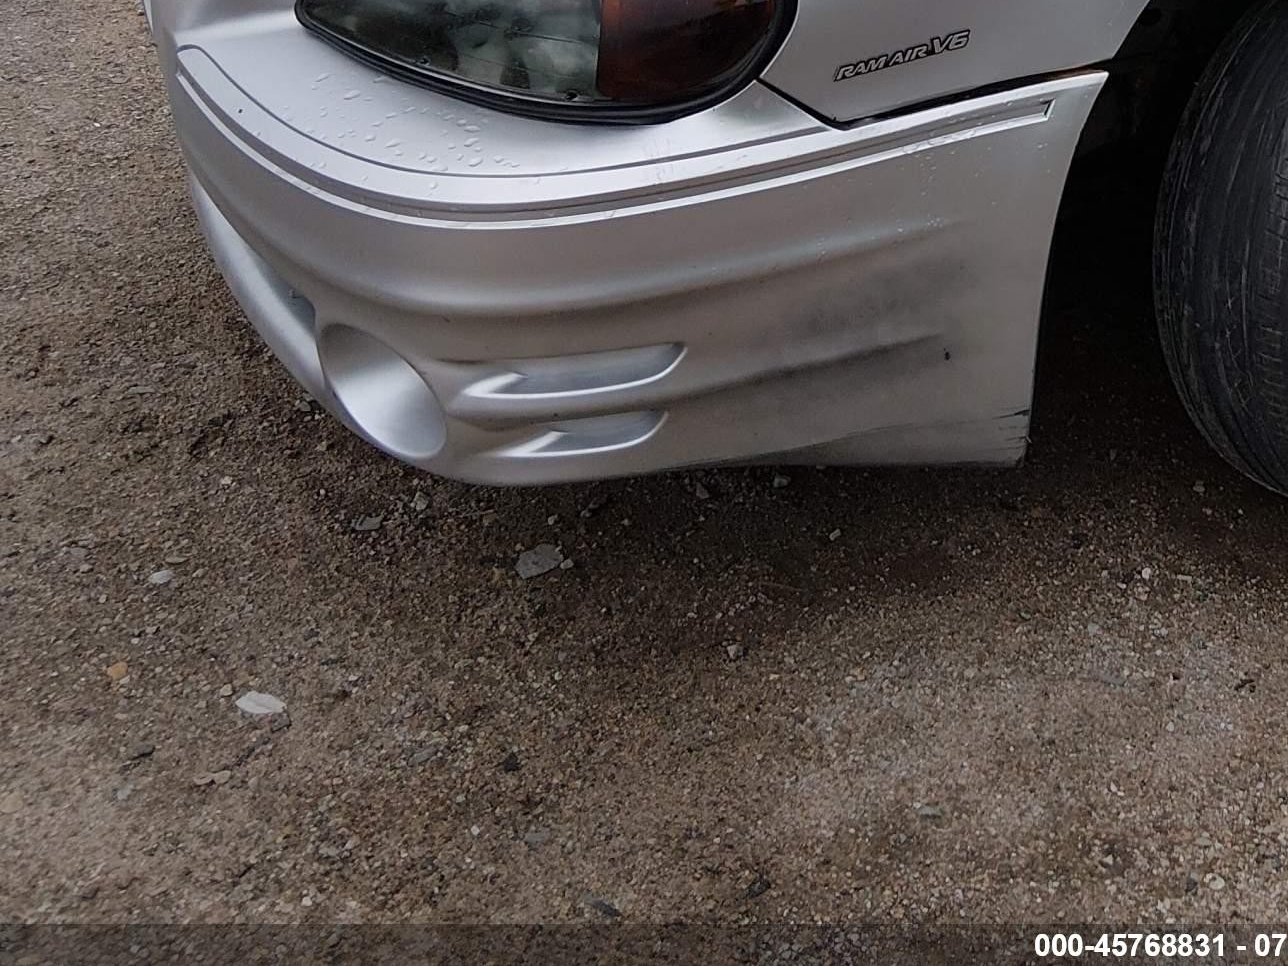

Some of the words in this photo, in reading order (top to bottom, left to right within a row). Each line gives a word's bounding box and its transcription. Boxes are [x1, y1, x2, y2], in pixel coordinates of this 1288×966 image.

[834, 54, 888, 81] RAM
[888, 43, 928, 67] AIR
[930, 29, 970, 55] V6
